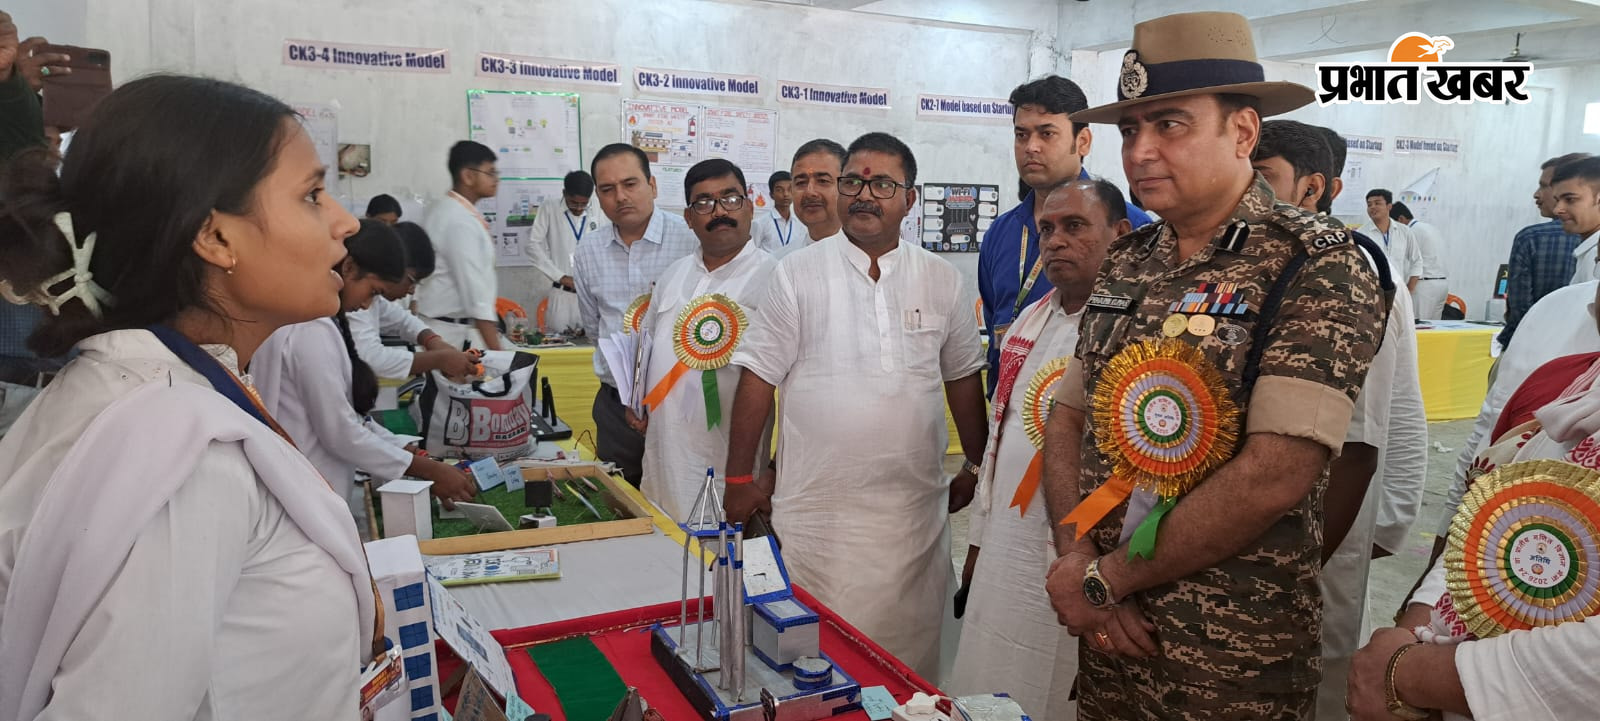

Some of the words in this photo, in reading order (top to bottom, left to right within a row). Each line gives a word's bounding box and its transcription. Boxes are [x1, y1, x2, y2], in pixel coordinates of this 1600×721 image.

[289, 44, 329, 62] CK3-4
[333, 48, 402, 67] Innovative
[405, 52, 445, 69] Model
[481, 57, 517, 74] CK3-3
[583, 66, 617, 82] Model
[638, 72, 669, 88] CK3-2
[672, 75, 726, 92] Innovative
[728, 79, 758, 94] Model
[781, 85, 808, 100] CK3-1
[810, 88, 857, 104] Innovative
[859, 92, 887, 106] Model
[940, 99, 960, 112] Model
[962, 100, 981, 113] based
[983, 104, 991, 114] on
[1529, 554, 1551, 565] अतिथि
